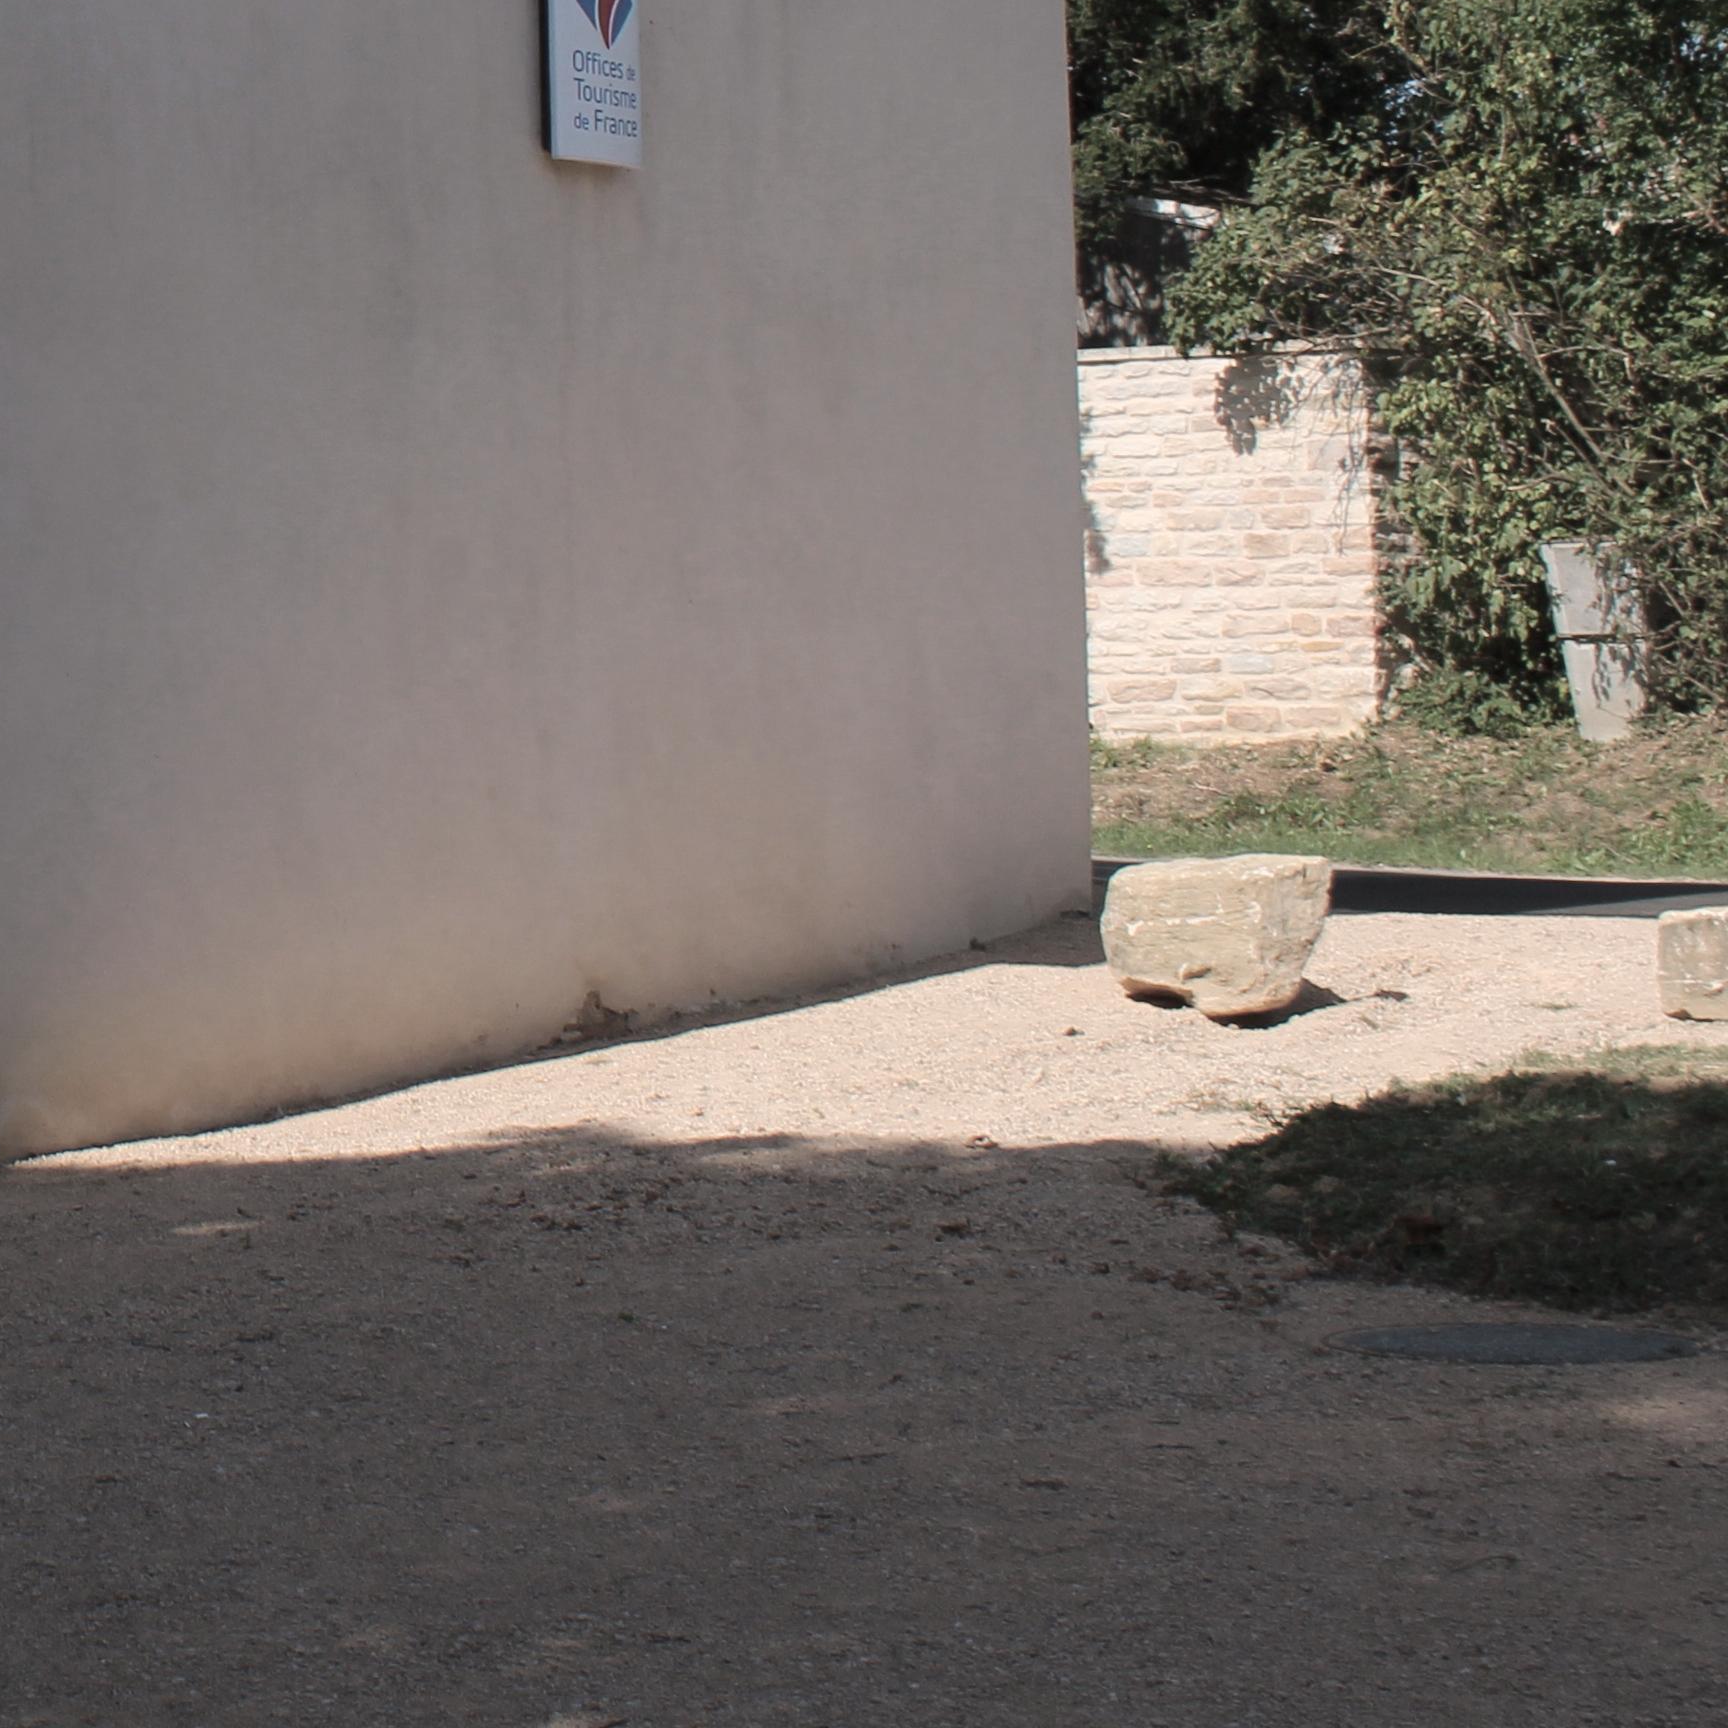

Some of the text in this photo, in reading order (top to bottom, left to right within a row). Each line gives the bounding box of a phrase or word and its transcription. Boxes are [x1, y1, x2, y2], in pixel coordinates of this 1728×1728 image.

[572, 49, 624, 80] Offices
[573, 77, 637, 111] Tourisme
[573, 109, 638, 138] de France
